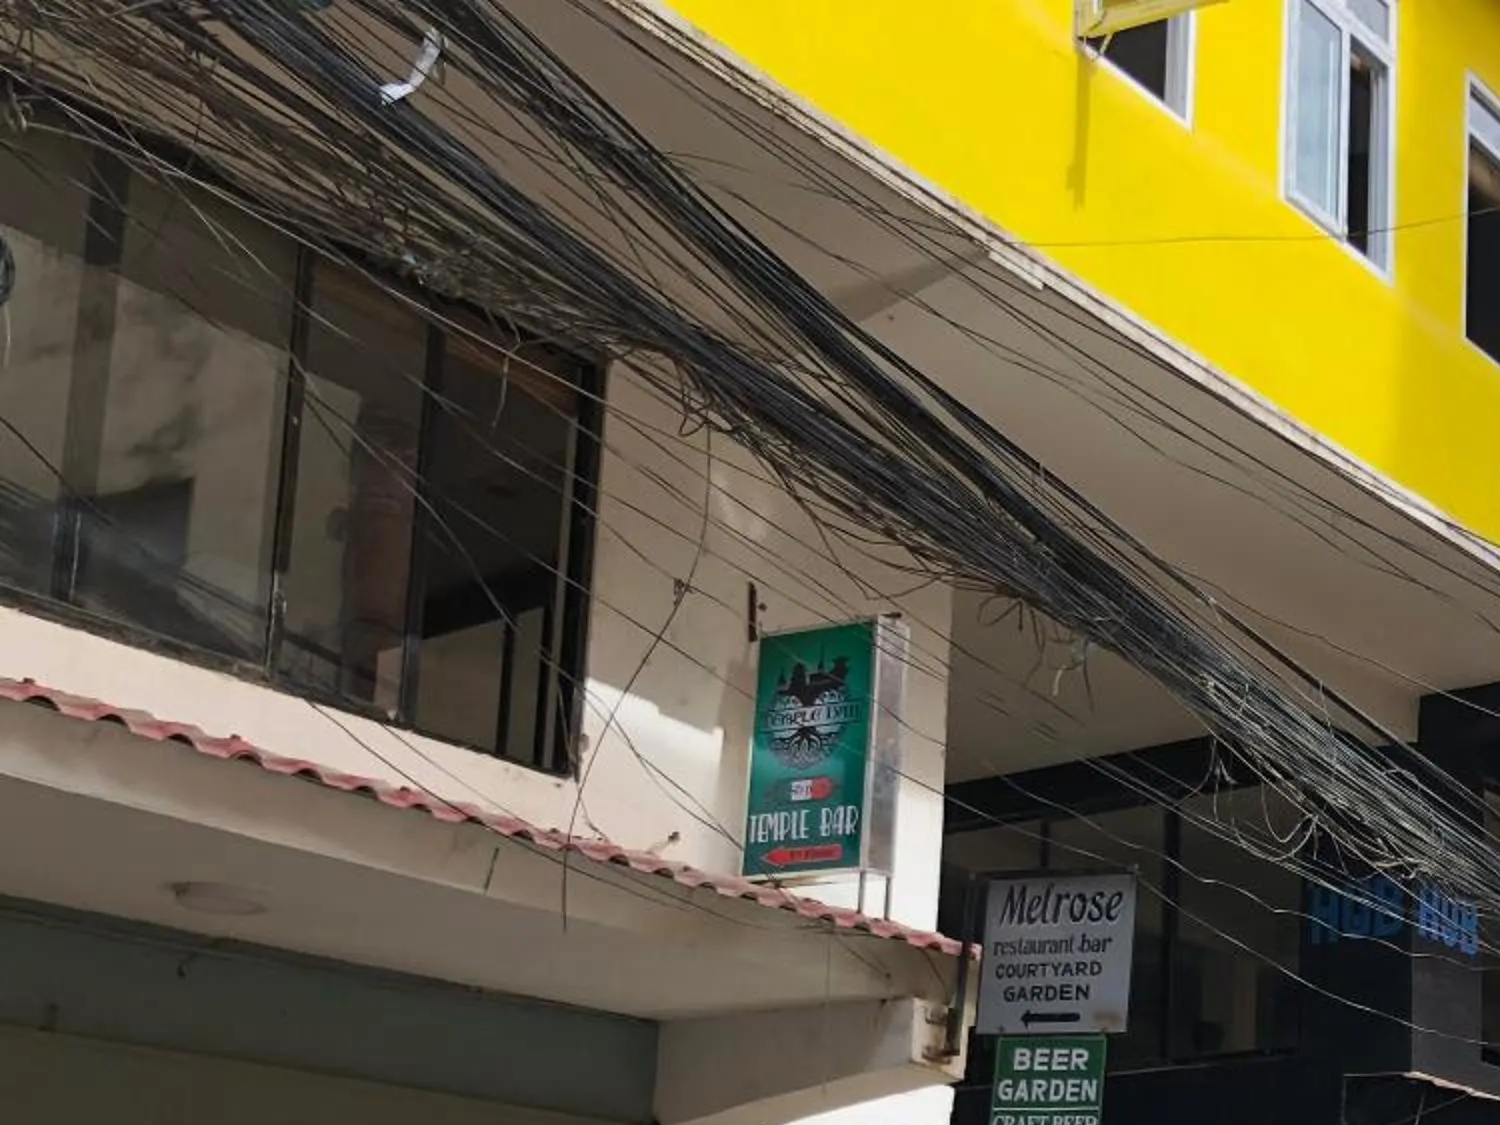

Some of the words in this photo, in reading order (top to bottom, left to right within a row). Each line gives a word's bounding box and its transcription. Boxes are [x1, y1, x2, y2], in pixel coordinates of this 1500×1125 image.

[750, 809, 810, 843] TEMPLE
[820, 805, 859, 837] BAR
[1001, 883, 1122, 926] Melrose
[993, 936, 1075, 956] restaurant
[995, 961, 1103, 979] COURTYARD
[1003, 984, 1090, 1002] GARDEN
[1013, 1047, 1089, 1071] BEER
[998, 1079, 1098, 1101] GARDEN
